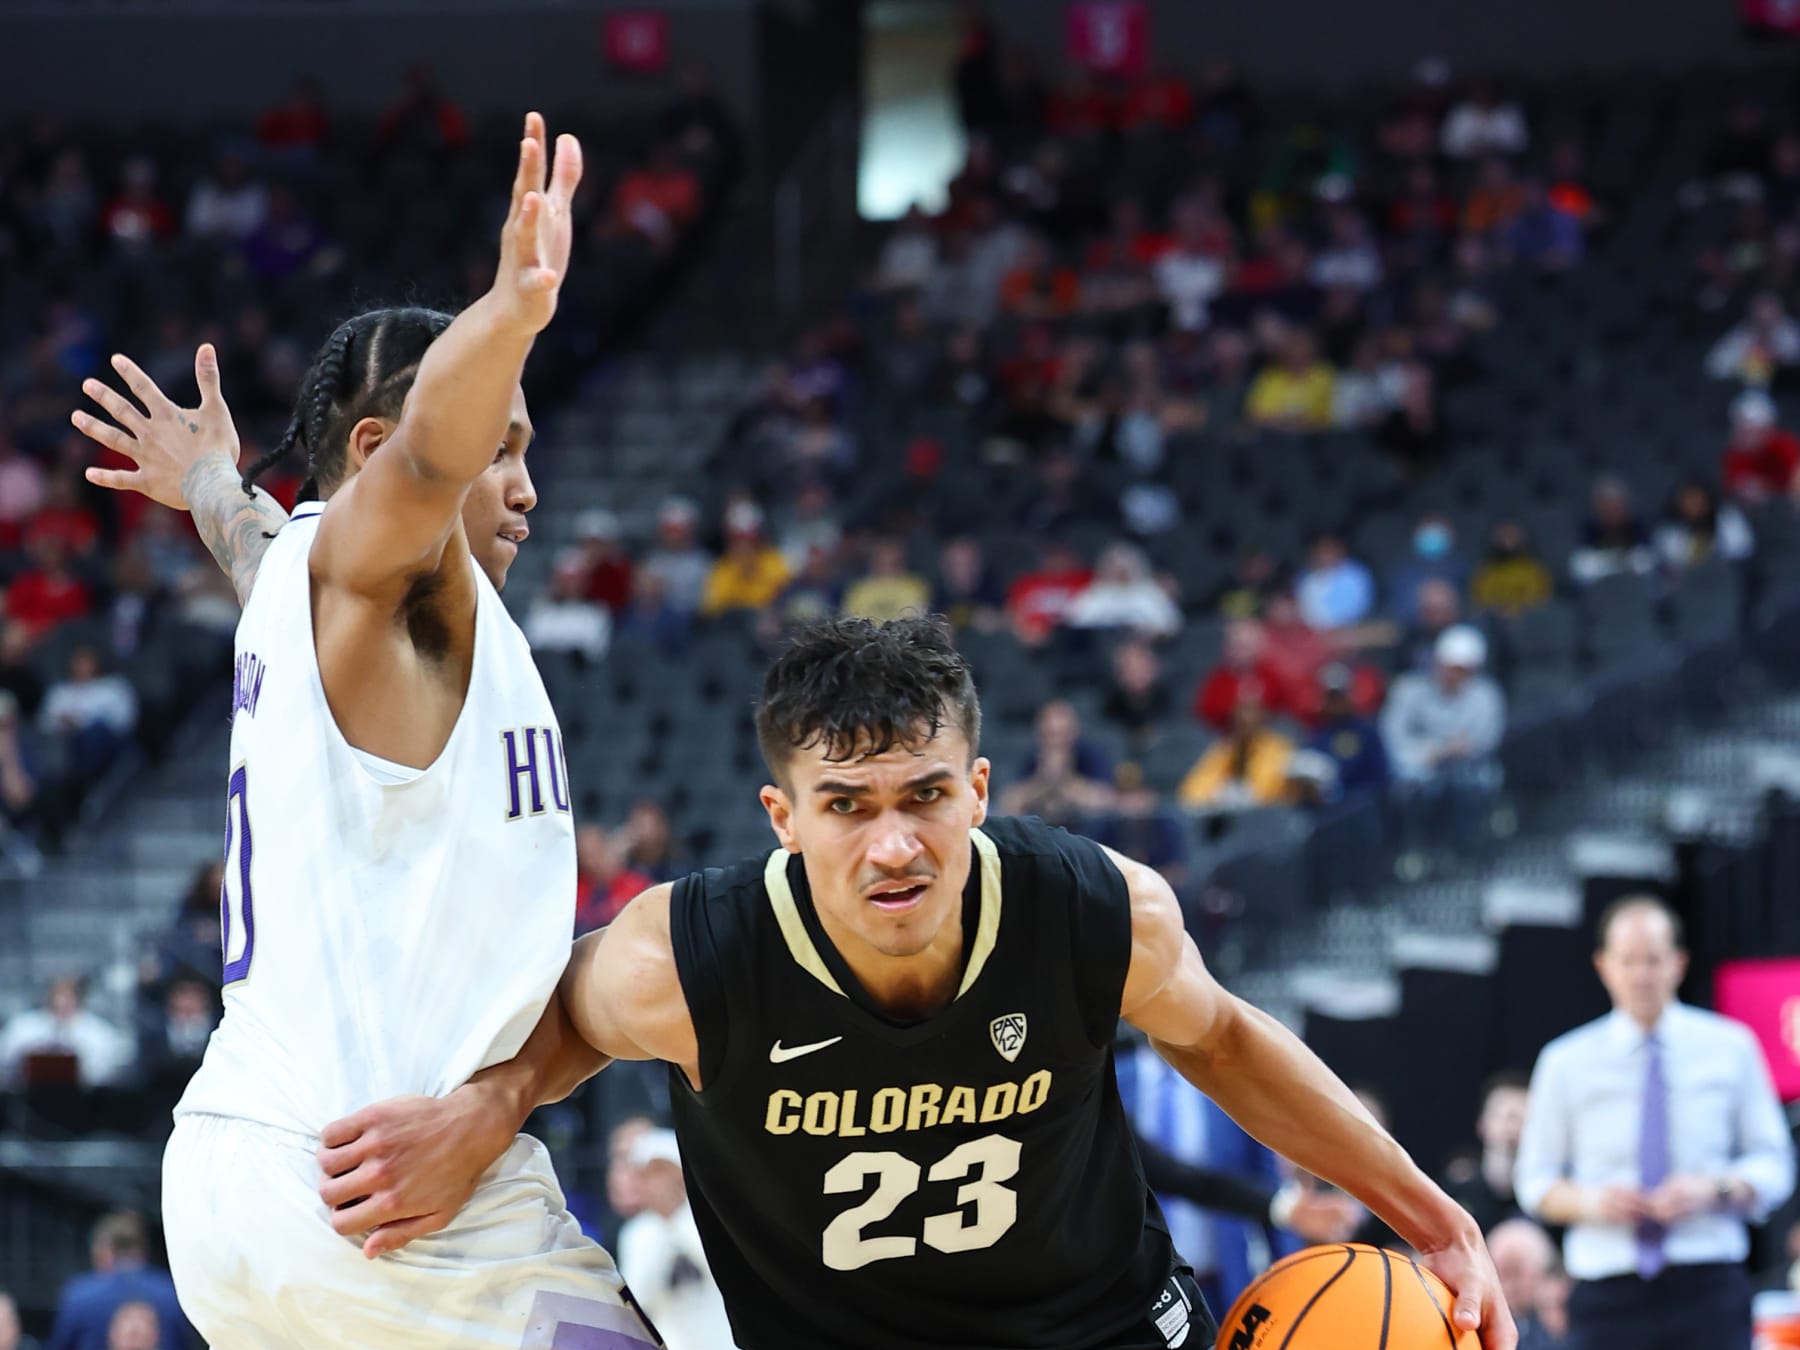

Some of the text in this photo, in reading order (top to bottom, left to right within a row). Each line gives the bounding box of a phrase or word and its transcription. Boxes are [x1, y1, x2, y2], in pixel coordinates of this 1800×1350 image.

[993, 1016, 1024, 1045] PAC
[1002, 1034, 1018, 1052] 12
[764, 1069, 1052, 1137] COLORADO
[822, 1133, 1023, 1271] 23
